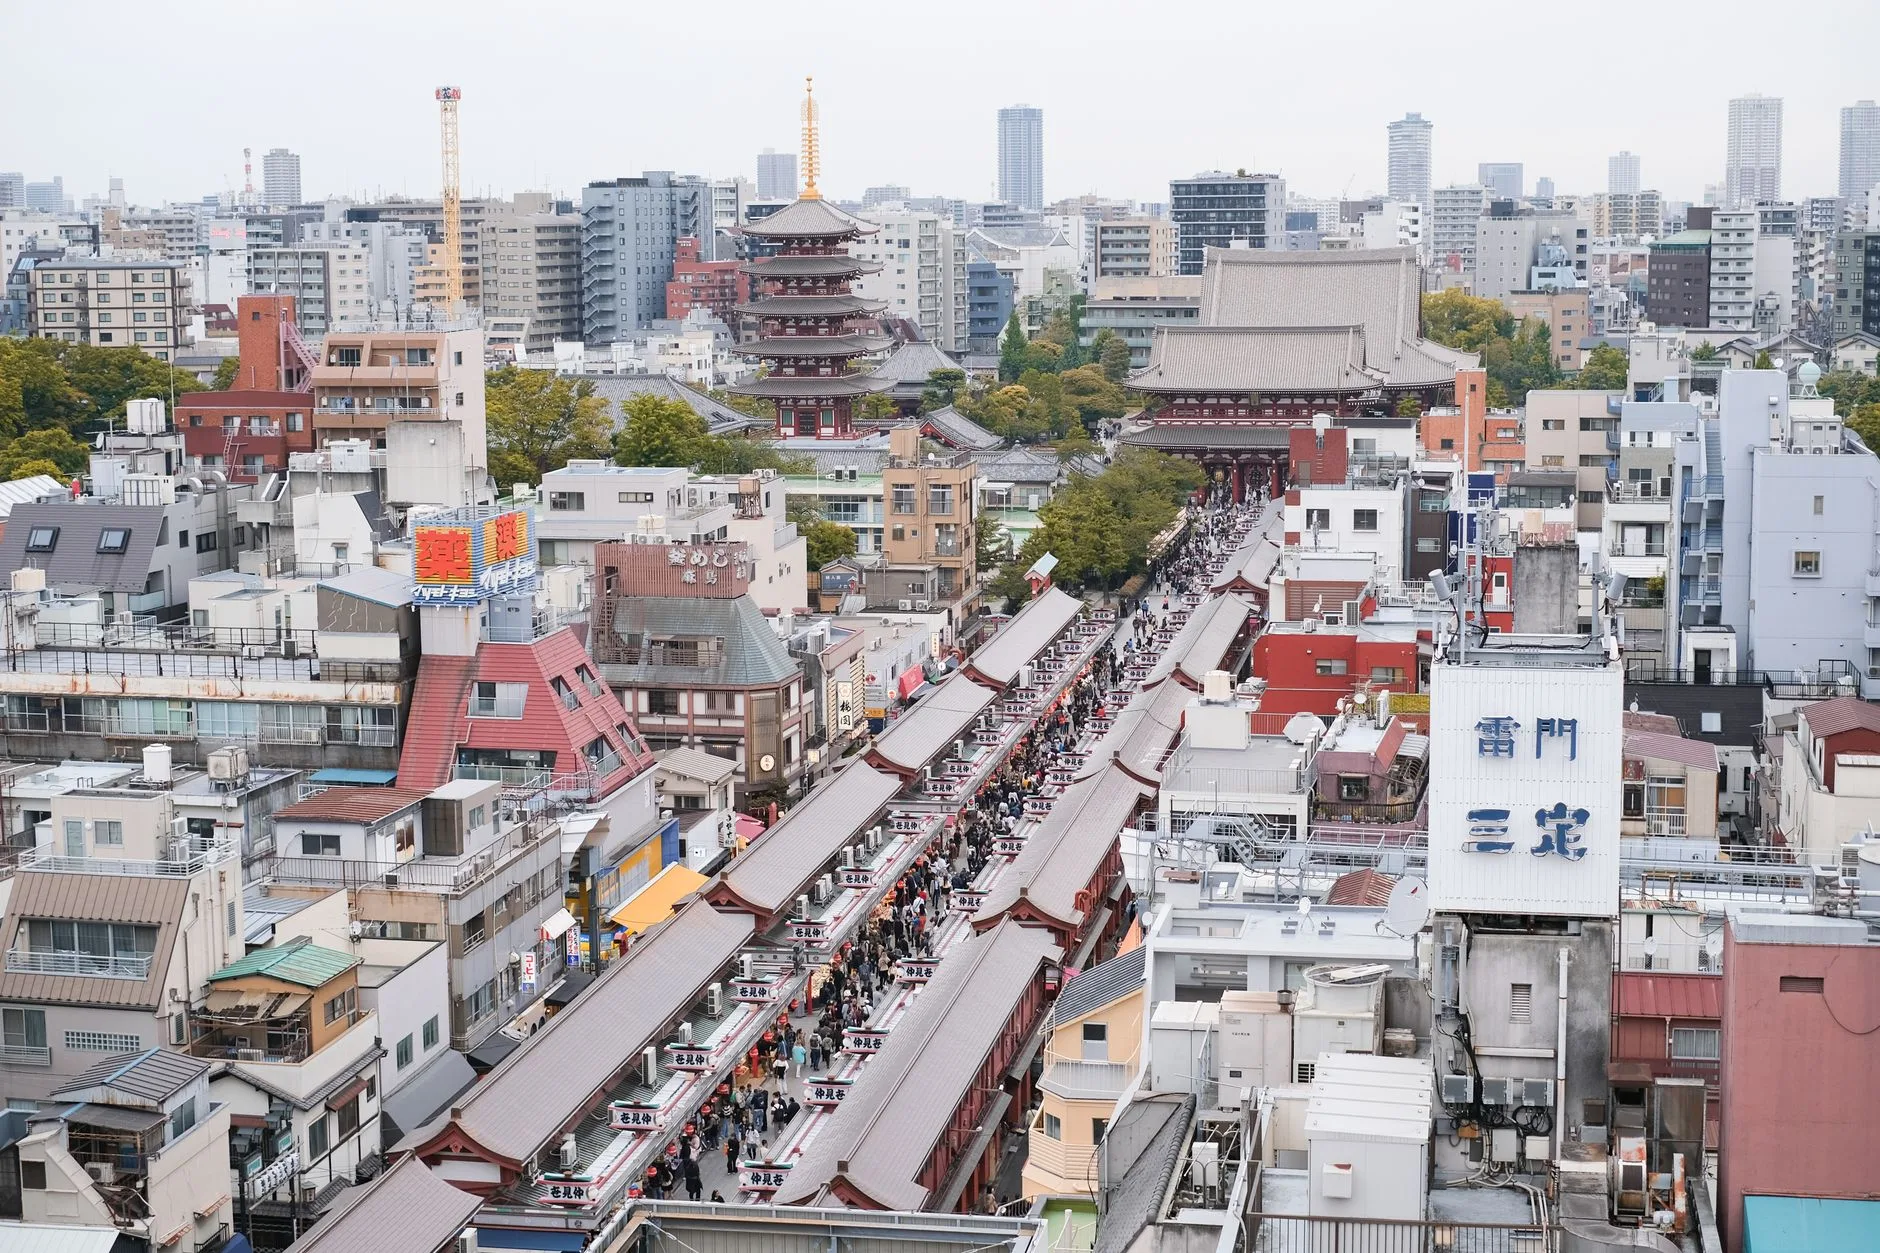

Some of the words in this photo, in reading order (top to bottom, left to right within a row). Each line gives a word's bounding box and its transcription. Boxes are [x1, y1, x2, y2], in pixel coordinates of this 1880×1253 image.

[416, 530, 469, 580] 薬
[495, 512, 518, 560] 薬
[668, 547, 728, 568] 釜めし
[1474, 715, 1578, 761] 雷門
[1461, 801, 1590, 862] 三定
[525, 954, 534, 980] コーヒー
